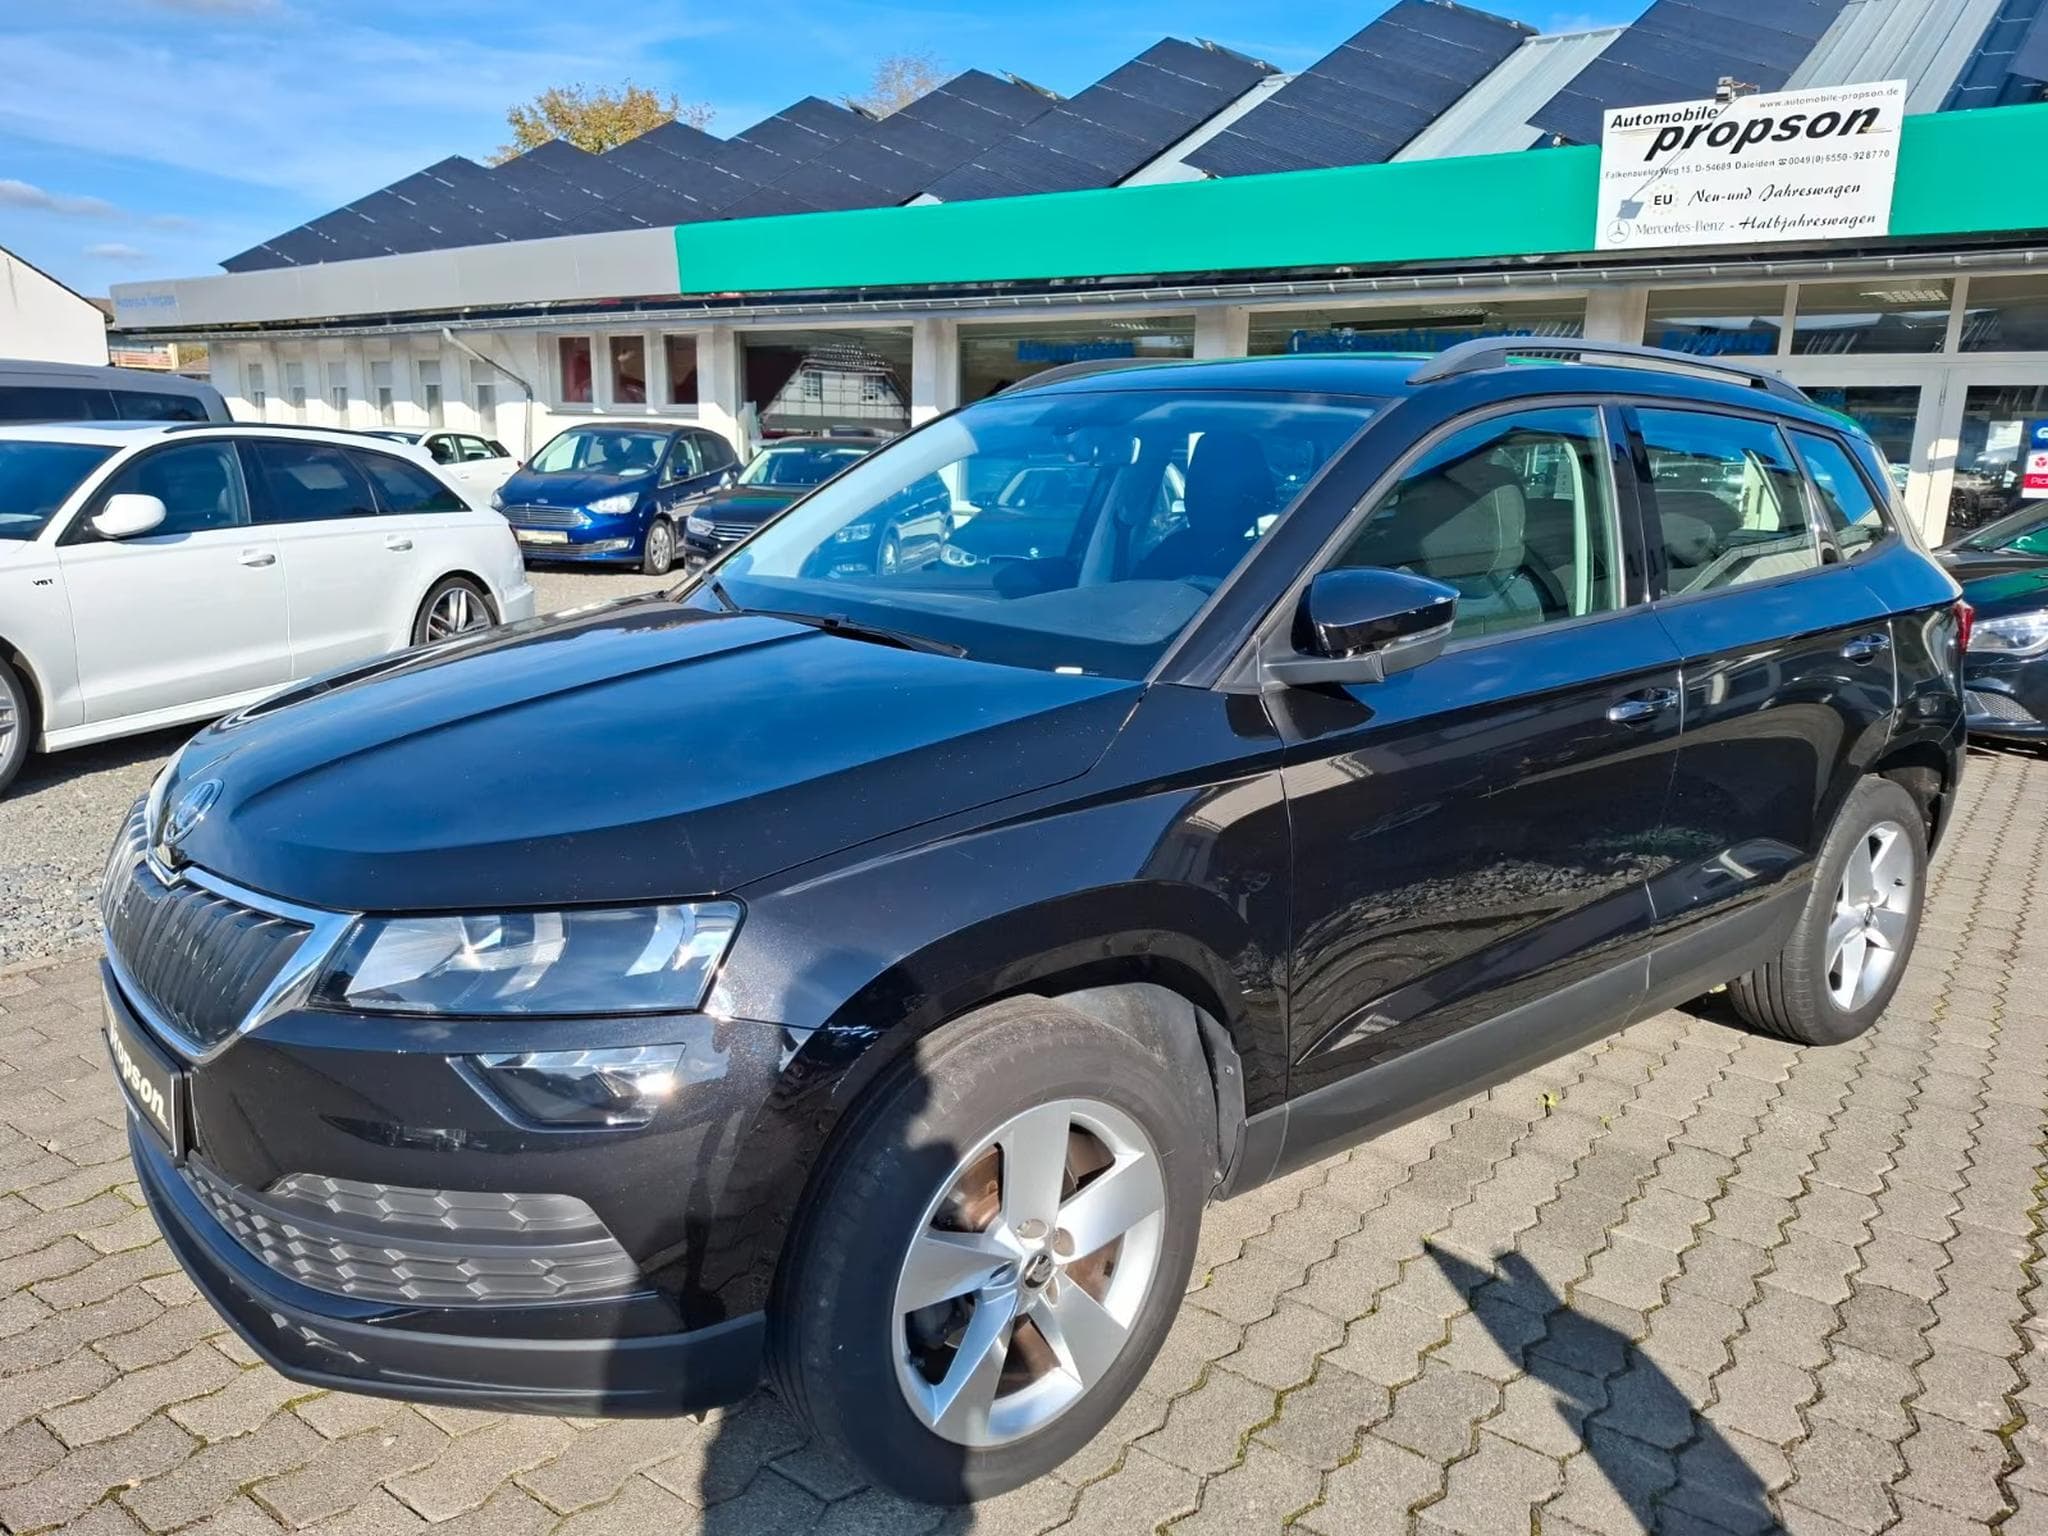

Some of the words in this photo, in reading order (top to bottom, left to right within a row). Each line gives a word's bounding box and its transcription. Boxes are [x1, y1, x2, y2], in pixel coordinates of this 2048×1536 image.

[1610, 106, 1719, 129] Automobile
[1643, 106, 1881, 162] propson
[1653, 193, 1673, 206] EU
[1759, 183, 1861, 202] Jahreswagen
[1635, 220, 1725, 236] Mercedes-Benz
